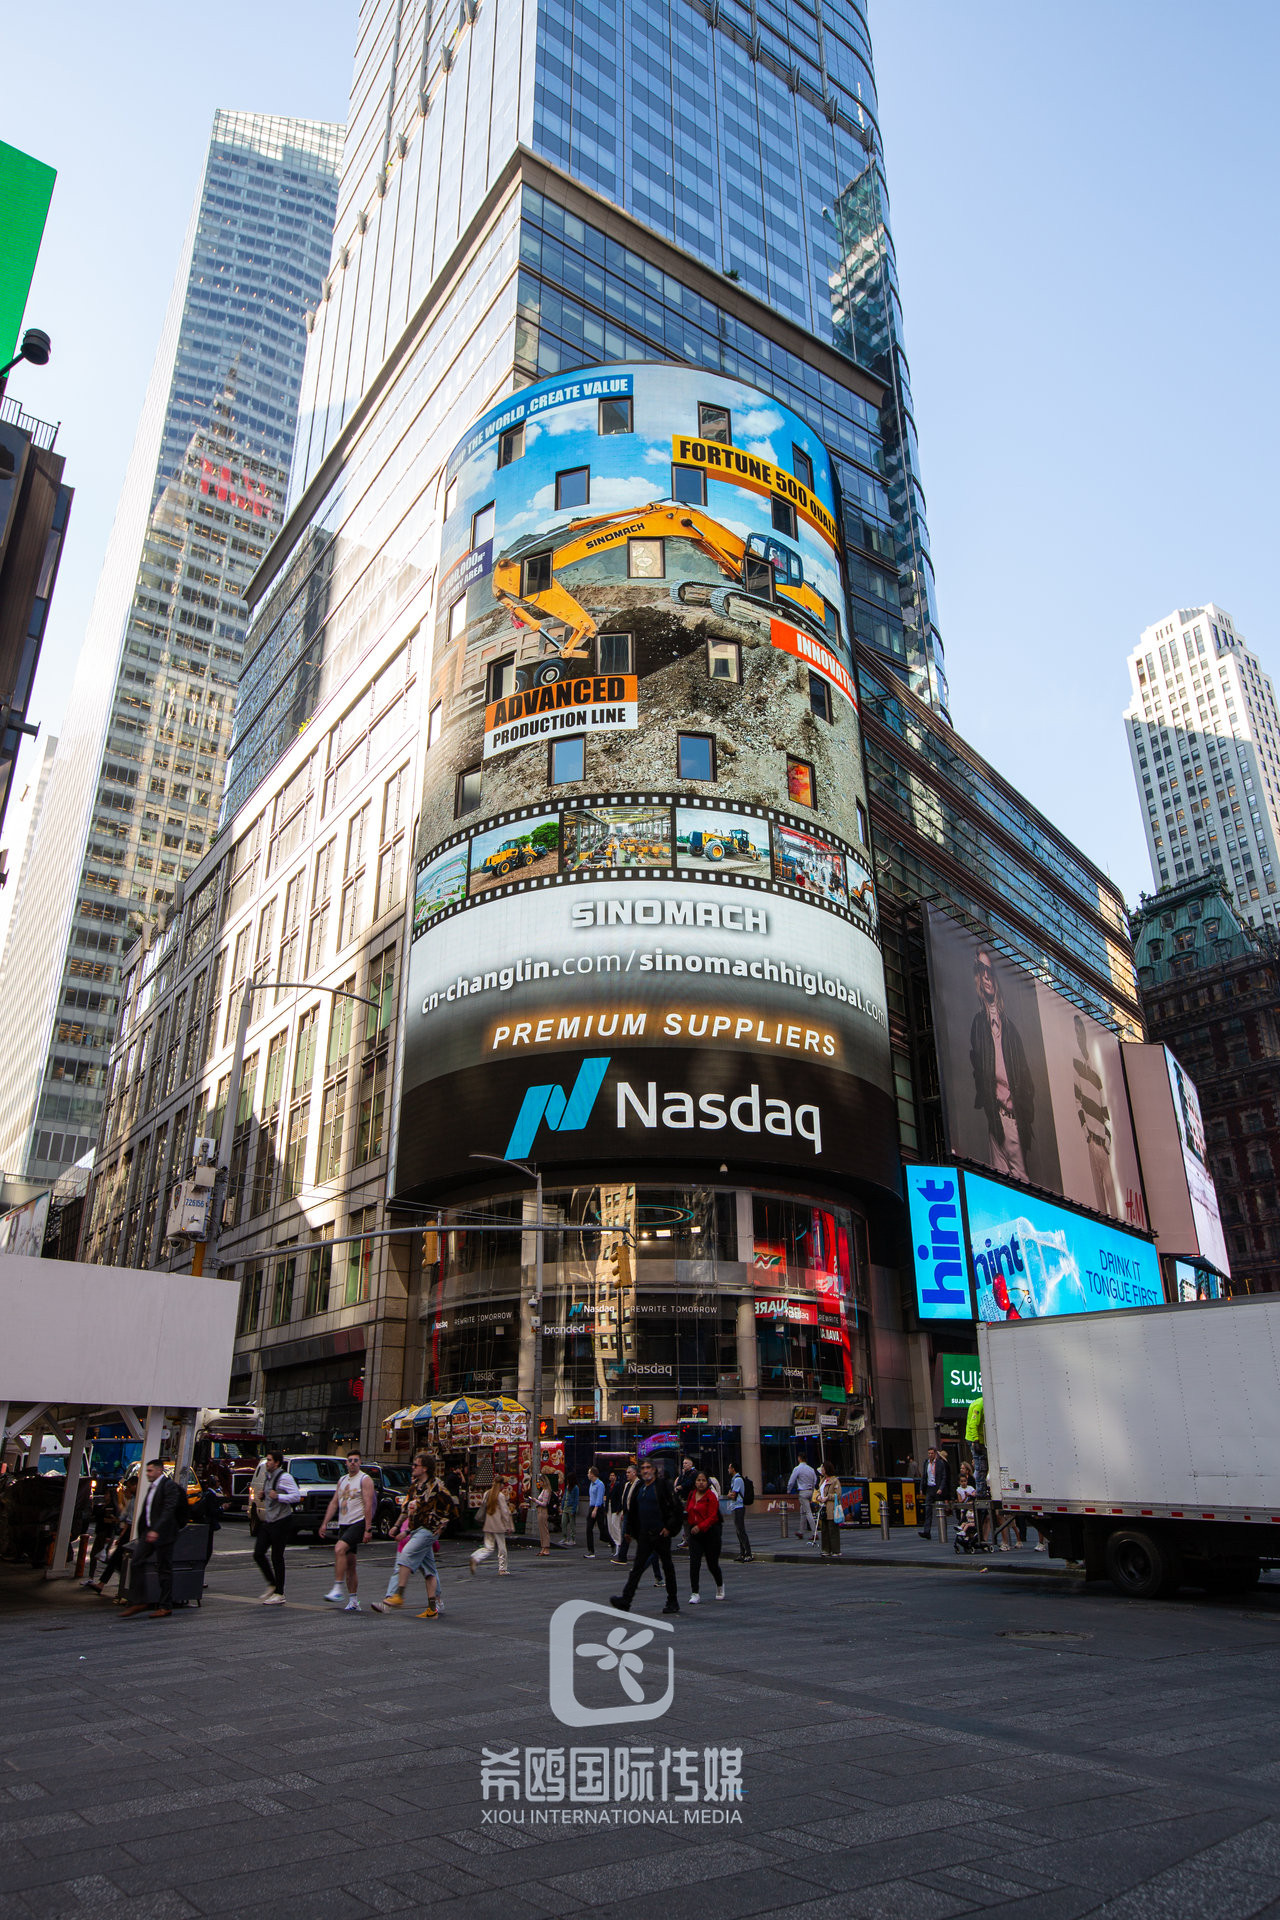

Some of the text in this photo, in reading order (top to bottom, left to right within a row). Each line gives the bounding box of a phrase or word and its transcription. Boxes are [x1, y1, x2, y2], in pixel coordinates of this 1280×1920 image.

[467, 433, 484, 454] THE
[484, 405, 525, 440] WORLD
[583, 379, 629, 397] VALUE
[679, 440, 772, 485] FORTUNE
[775, 470, 808, 508] 500
[586, 522, 646, 550] SINOMACH
[464, 564, 483, 585] AREA
[493, 677, 625, 727] ADVANCED
[492, 708, 626, 748] PRODUCTION LINE
[571, 899, 767, 934] SINOMACH
[492, 1013, 836, 1057] PREMIUM SUPPLIERS
[616, 1081, 822, 1155] Nasdaq
[1125, 1187, 1145, 1226] H&M
[917, 1179, 966, 1304] hint
[972, 1232, 1024, 1290] hint
[1099, 1249, 1140, 1282] DRINK IT
[1085, 1269, 1157, 1306] TONGUE FIRST
[477, 1311, 513, 1323] TOMORROW
[583, 1304, 718, 1314] Nasdaq REWRITE TOMORROW
[628, 1362, 673, 1376] Nasdaq
